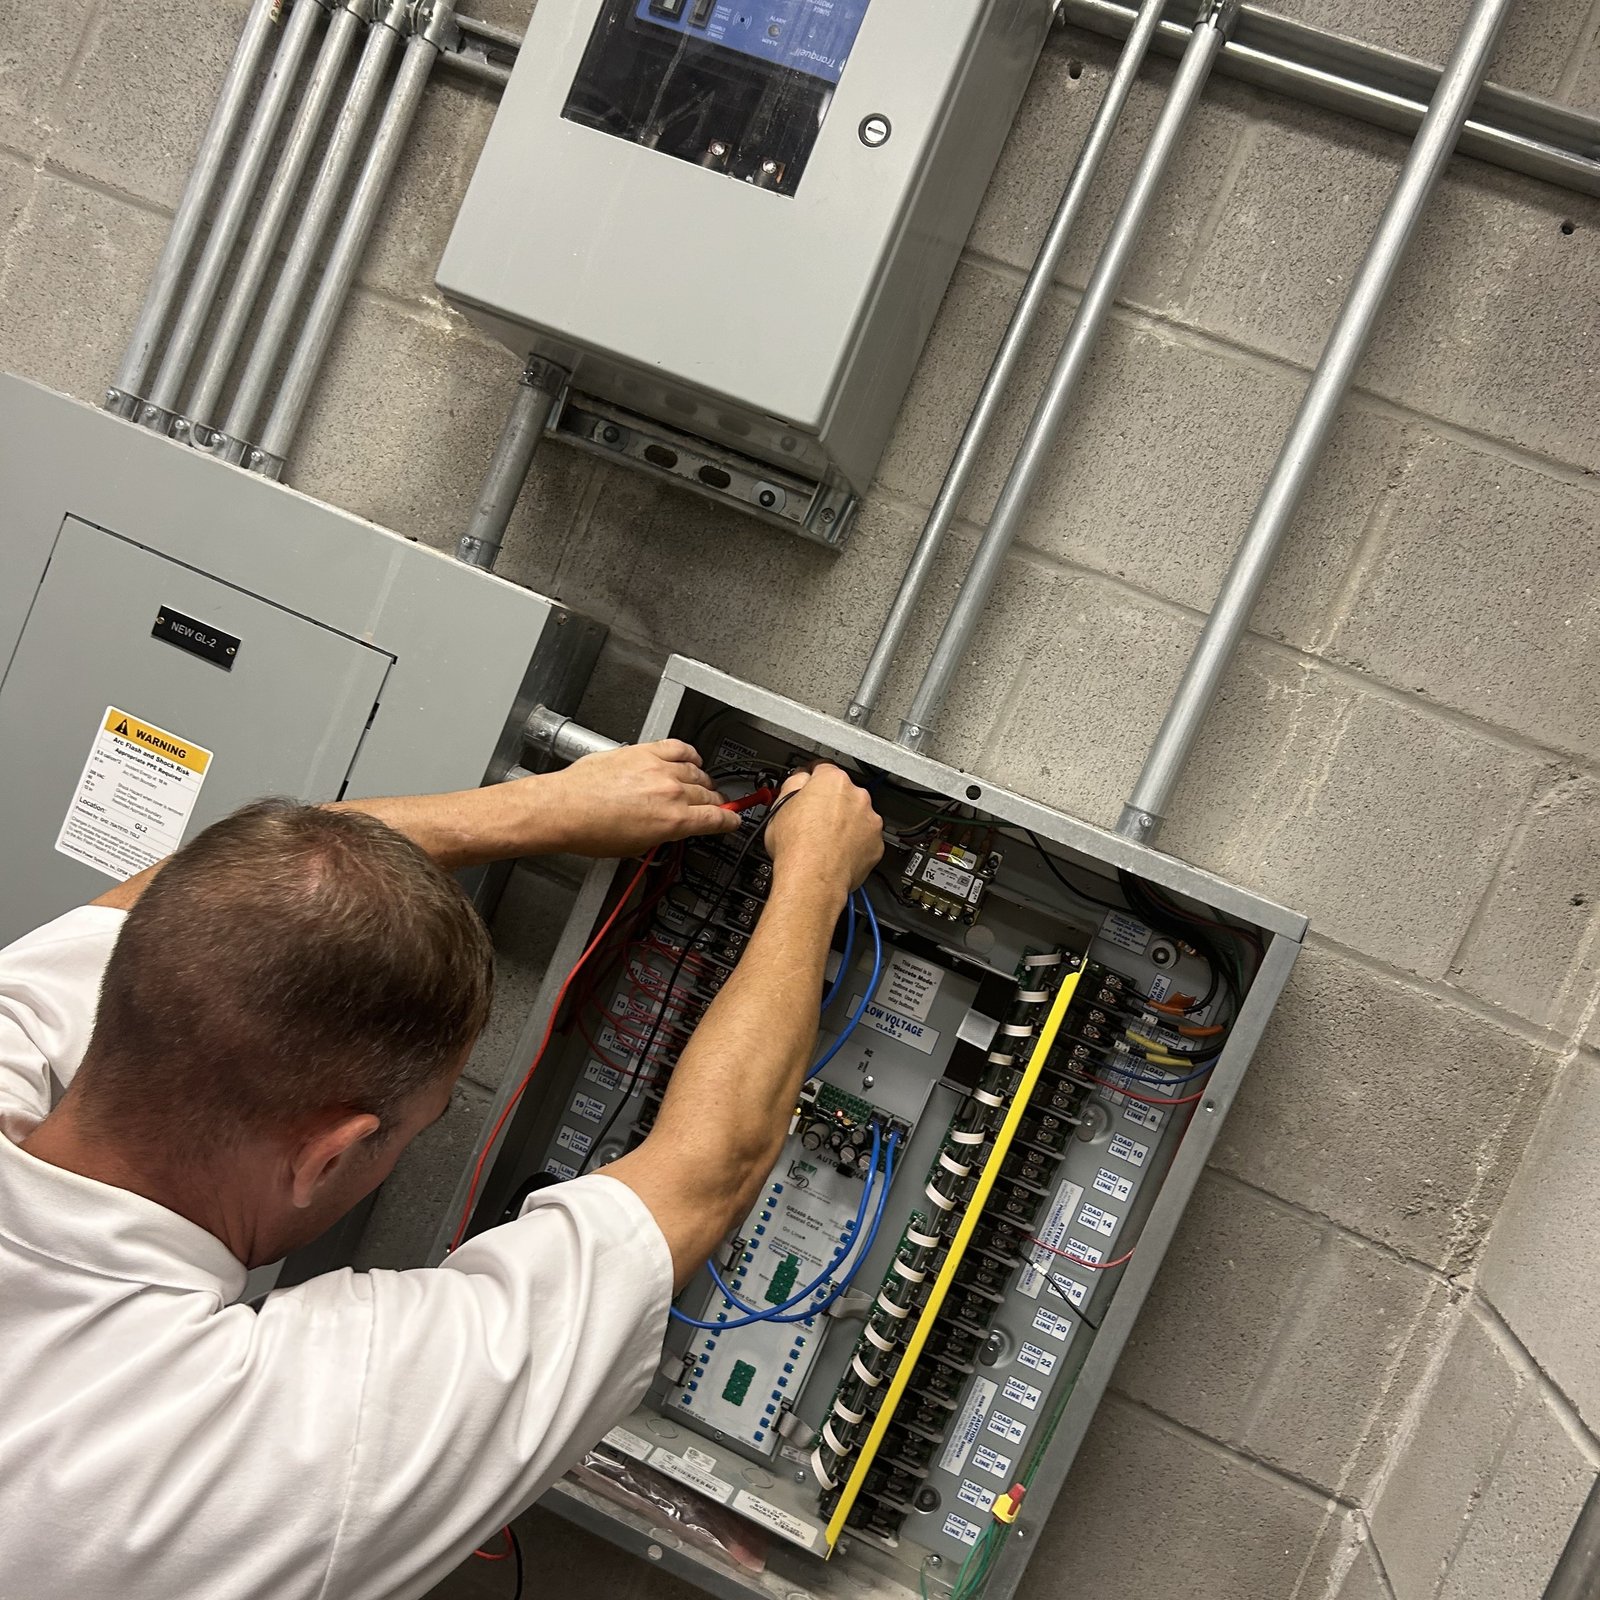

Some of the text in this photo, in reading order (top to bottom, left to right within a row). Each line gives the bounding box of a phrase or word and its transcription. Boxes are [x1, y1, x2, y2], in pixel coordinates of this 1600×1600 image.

[169, 620, 217, 648] NEW GL-2
[134, 728, 188, 759] WARNING
[112, 736, 190, 777] Arc Flash and Shock Risk
[113, 746, 146, 766] Appropriate
[156, 766, 182, 783] Required
[133, 822, 148, 833] GL2
[901, 959, 911, 967] This
[892, 971, 902, 980] The
[900, 976, 913, 986] green
[892, 980, 908, 992] buttons
[903, 994, 913, 1002] Use
[615, 1000, 626, 1009] 13
[863, 1002, 925, 1039] LOW VOLTAGE
[875, 1021, 896, 1036] CLASS
[602, 1033, 612, 1042] 15
[611, 1042, 630, 1054] LOAD
[588, 1066, 598, 1074] 17
[601, 1067, 616, 1077] LINE
[1145, 1064, 1164, 1076] LOAD
[598, 1075, 615, 1087] LOAD
[574, 1099, 584, 1108] 19
[588, 1100, 602, 1110] LINE
[1128, 1099, 1148, 1112] LOAD
[584, 1109, 602, 1120] LOAD
[1126, 1109, 1143, 1121] LINE
[560, 1132, 570, 1140] 21
[574, 1133, 588, 1143] LINE
[1113, 1134, 1132, 1147] LOAD
[570, 1142, 588, 1153] LOAD
[1110, 1145, 1127, 1157] LINE
[1132, 1149, 1143, 1158] 10
[546, 1165, 557, 1174] 23
[560, 1166, 575, 1176] LINE
[1098, 1169, 1117, 1182] LOAD
[1095, 1179, 1112, 1191] LINE
[1116, 1184, 1128, 1194] 12
[1082, 1204, 1102, 1217] LOAD
[785, 1210, 806, 1224] Control
[805, 1220, 820, 1231] Card
[805, 1214, 824, 1226] Series
[1079, 1215, 1097, 1227] LINE
[1101, 1219, 1112, 1228] 14
[1043, 1222, 1066, 1261] ATTENTON:
[1067, 1239, 1087, 1252] LOAD
[1085, 1253, 1097, 1263] 16
[1052, 1274, 1072, 1287] LOAD
[1070, 1289, 1081, 1298] 18
[1037, 1309, 1057, 1322] LOAD
[1034, 1319, 1051, 1331] LINE
[1054, 1323, 1067, 1333] 20
[1022, 1343, 1042, 1356] LOAD
[1019, 1354, 1036, 1365] LINE
[1039, 1357, 1052, 1367] 22
[1006, 1378, 1026, 1391] LOAD
[1004, 1388, 1021, 1400] LINE
[1024, 1392, 1036, 1402] 24
[992, 1412, 1012, 1425] LOAD
[965, 1413, 984, 1444] CAUTION:
[989, 1422, 1006, 1433] LINE
[1009, 1426, 1021, 1436] 26
[977, 1446, 997, 1459] LOAD
[974, 1457, 990, 1469] LINE
[994, 1460, 1007, 1471] 28
[962, 1480, 982, 1494] LOAD
[959, 1491, 975, 1503] LINE
[979, 1494, 991, 1505] 30
[948, 1514, 967, 1527] LOAD
[944, 1525, 960, 1536] LINE
[964, 1528, 976, 1538] 32
